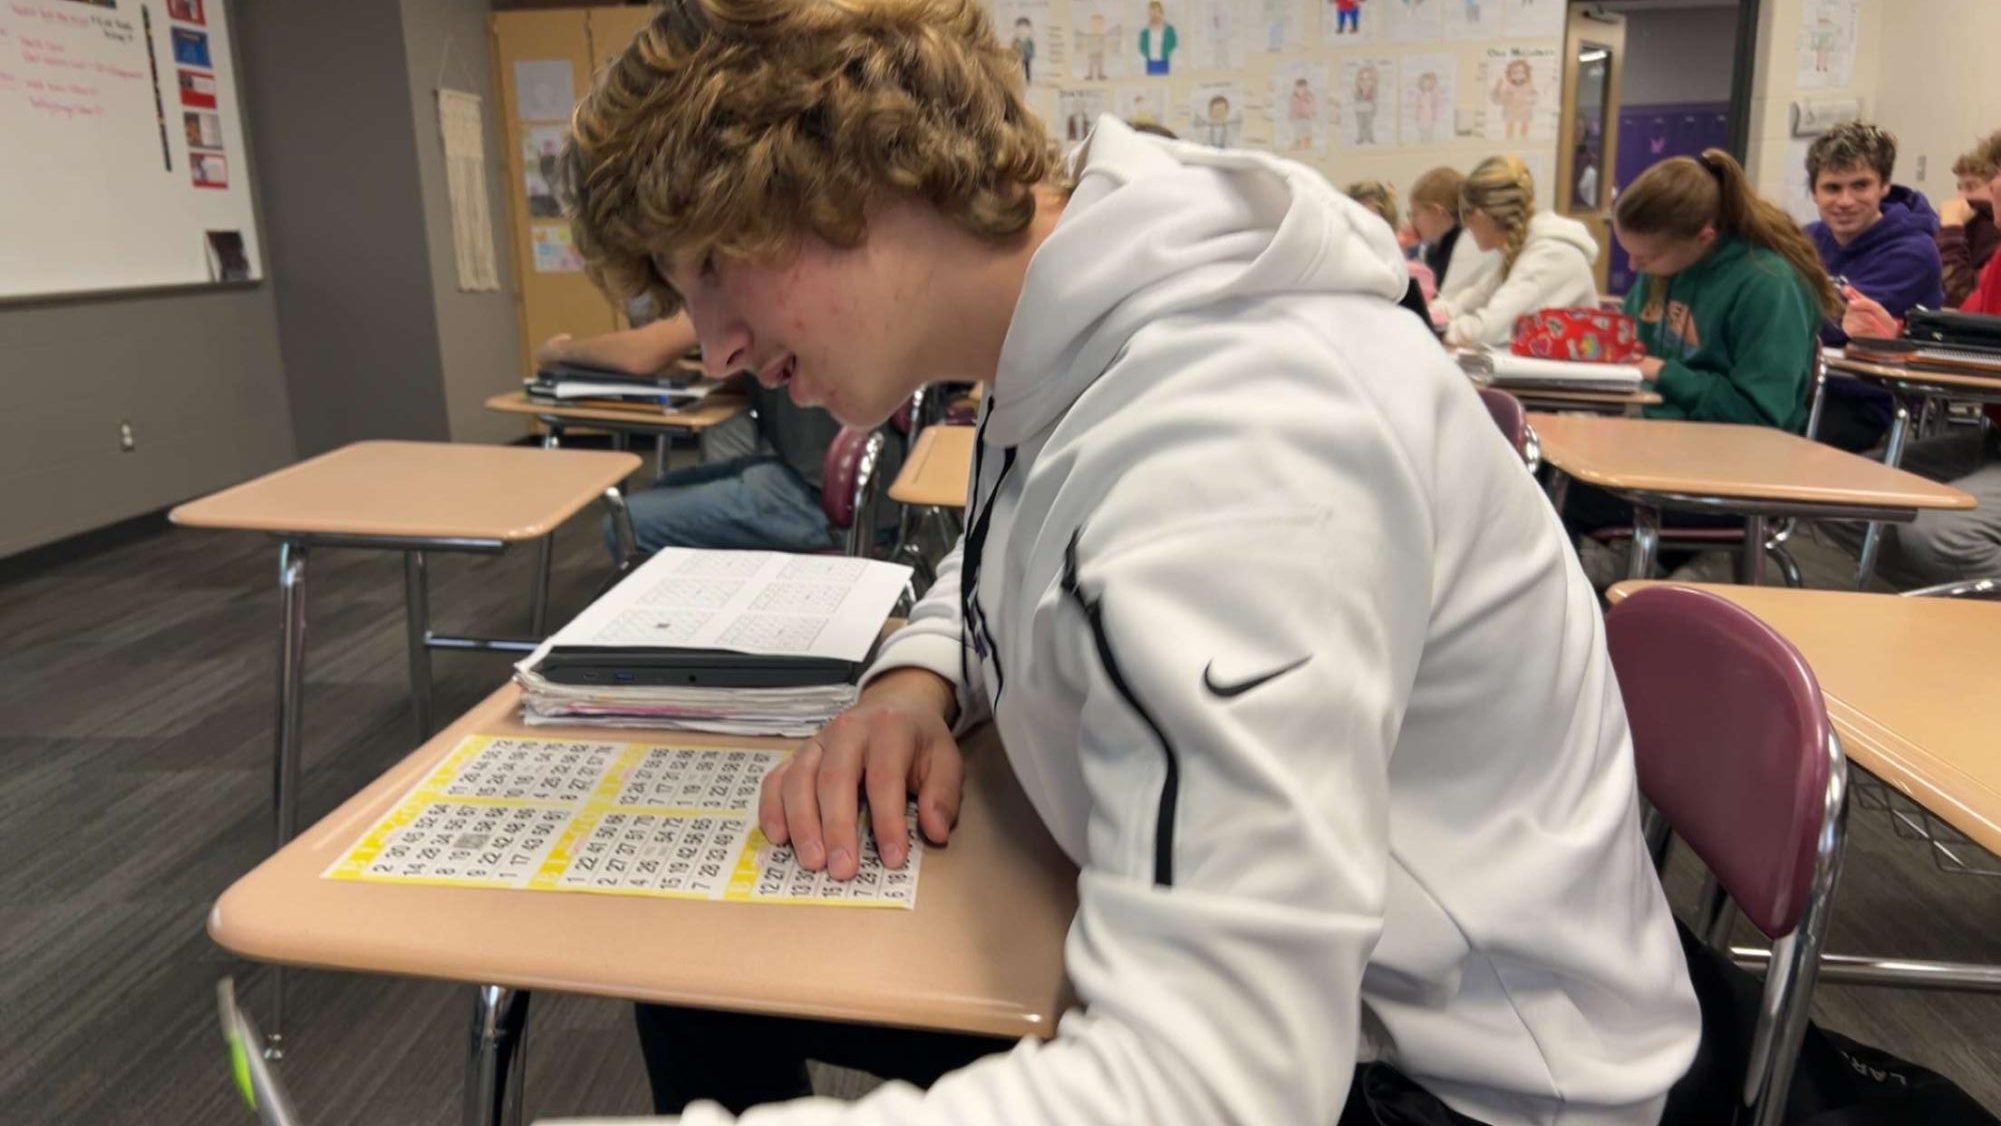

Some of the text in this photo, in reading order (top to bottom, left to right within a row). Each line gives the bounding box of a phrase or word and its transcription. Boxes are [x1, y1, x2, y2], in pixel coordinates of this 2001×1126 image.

[414, 817, 438, 829] 52
[662, 817, 684, 828] 72
[595, 827, 618, 839] 50
[654, 831, 675, 843] 54
[403, 863, 426, 876] 14
[456, 805, 475, 817] 67
[477, 852, 502, 865] 22
[492, 837, 514, 849] 42
[503, 822, 526, 834] 48
[509, 850, 531, 866] 17
[531, 824, 555, 835] 50
[586, 842, 608, 853] 41
[597, 815, 655, 886] 2 27 37 51 70
[660, 878, 682, 889] 15
[677, 847, 698, 859] 42
[691, 818, 712, 830] 65
[691, 881, 710, 889] 7
[705, 849, 728, 861] 33
[719, 820, 742, 832] 73
[771, 850, 794, 864] 42
[575, 857, 599, 871] 22
[860, 855, 882, 868] 34
[764, 867, 785, 880] 27
[759, 883, 780, 895] 12
[791, 884, 812, 896] 13
[821, 886, 843, 897] 15
[853, 889, 872, 897] 7
